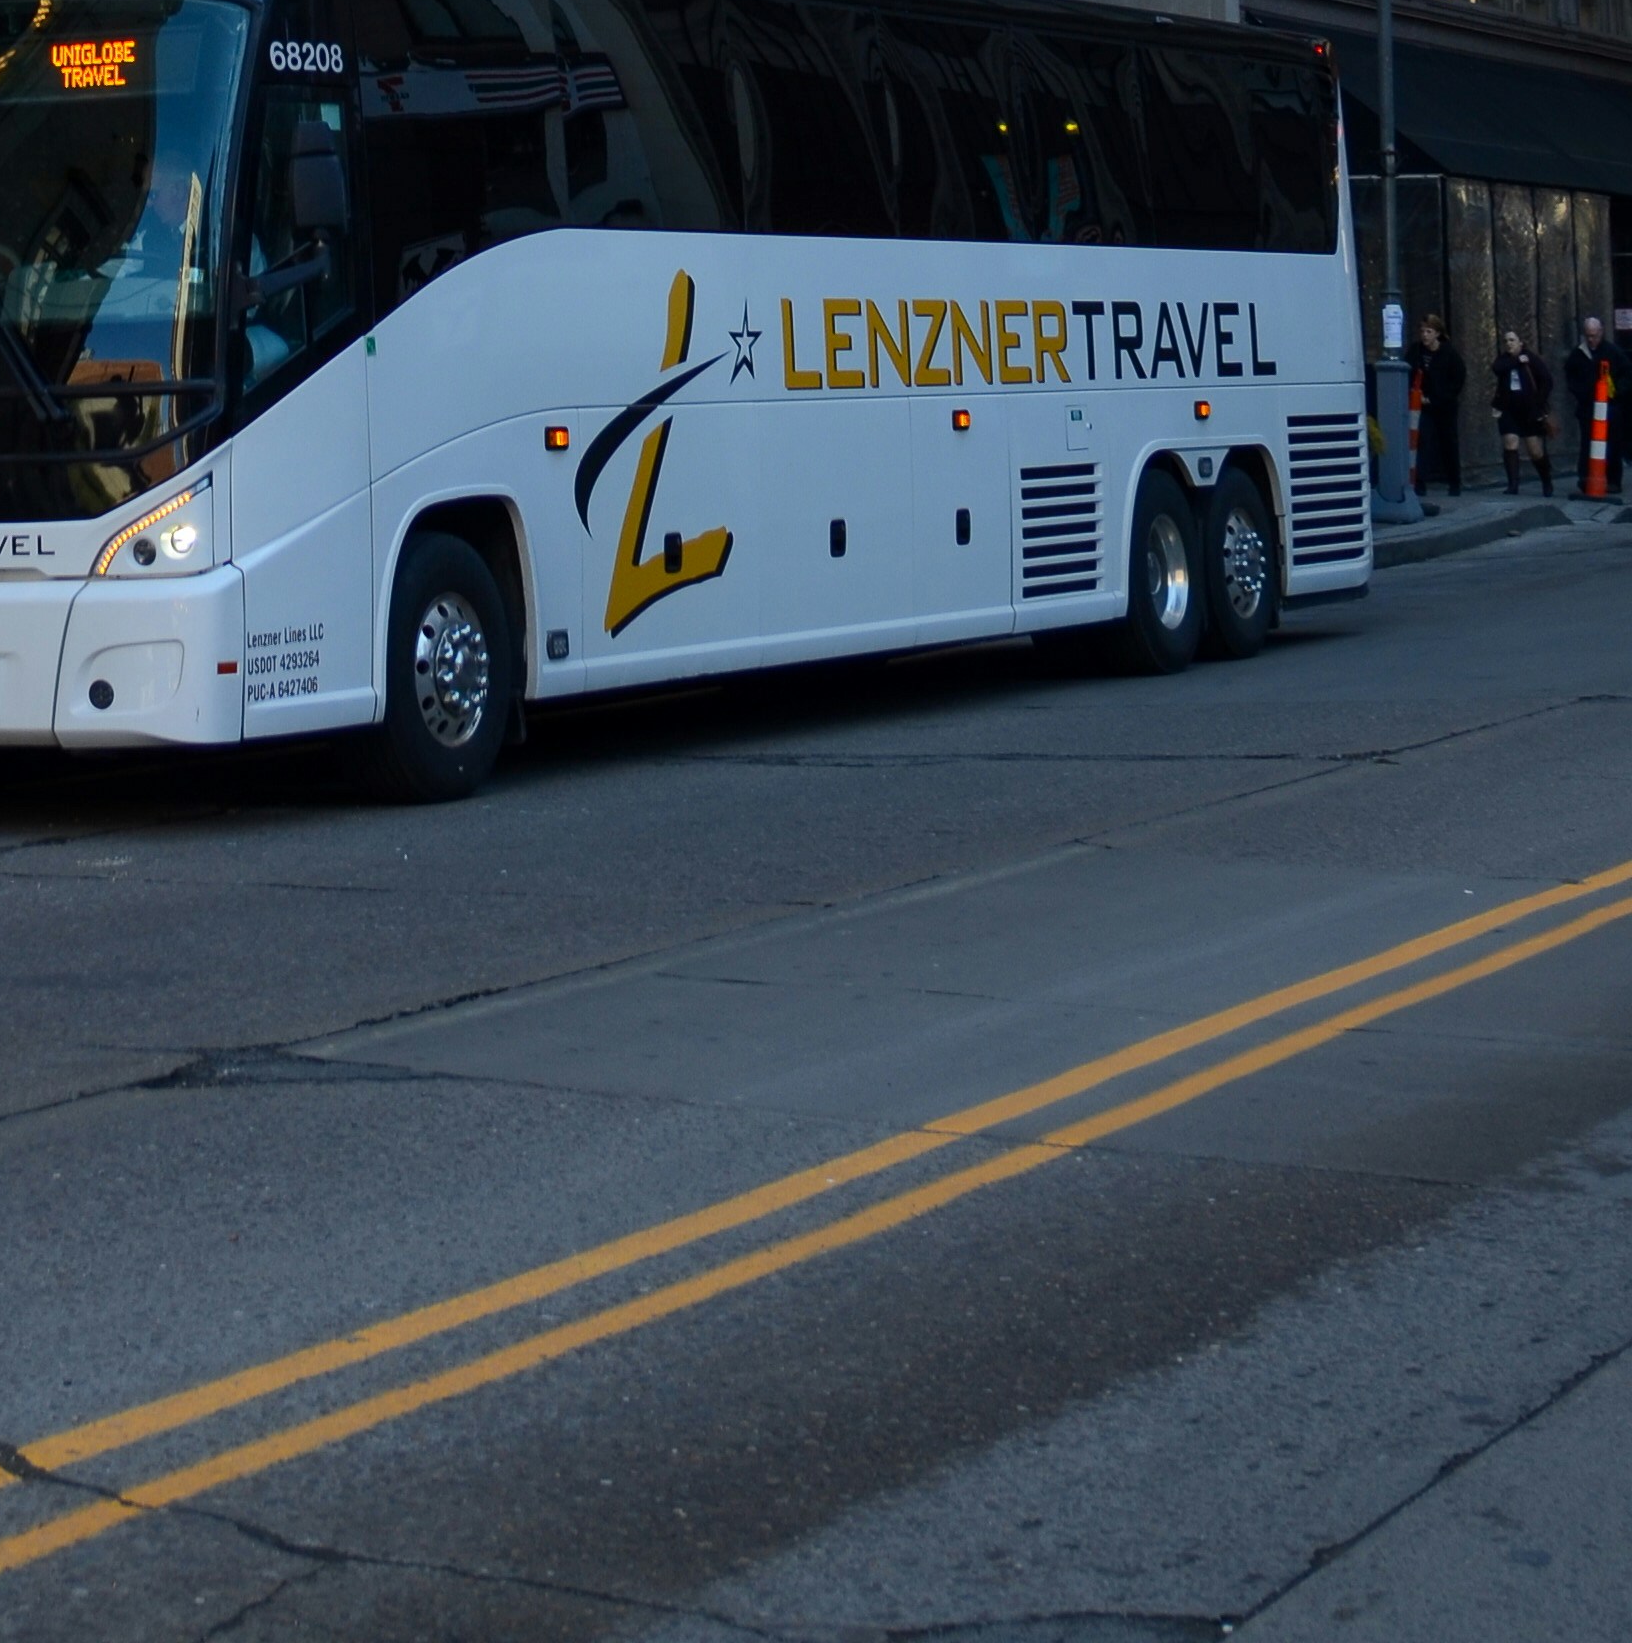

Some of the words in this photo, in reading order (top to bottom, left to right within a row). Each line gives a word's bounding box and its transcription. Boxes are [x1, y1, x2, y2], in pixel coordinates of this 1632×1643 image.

[52, 40, 136, 67] UNIGLOBE
[269, 40, 344, 74] 68208
[61, 64, 126, 89] TRAVEL
[247, 631, 282, 649] Lenzner
[284, 625, 307, 644] Lines
[308, 622, 325, 641] LLC
[247, 654, 278, 676] USDOT
[247, 680, 276, 702] PUC-A
